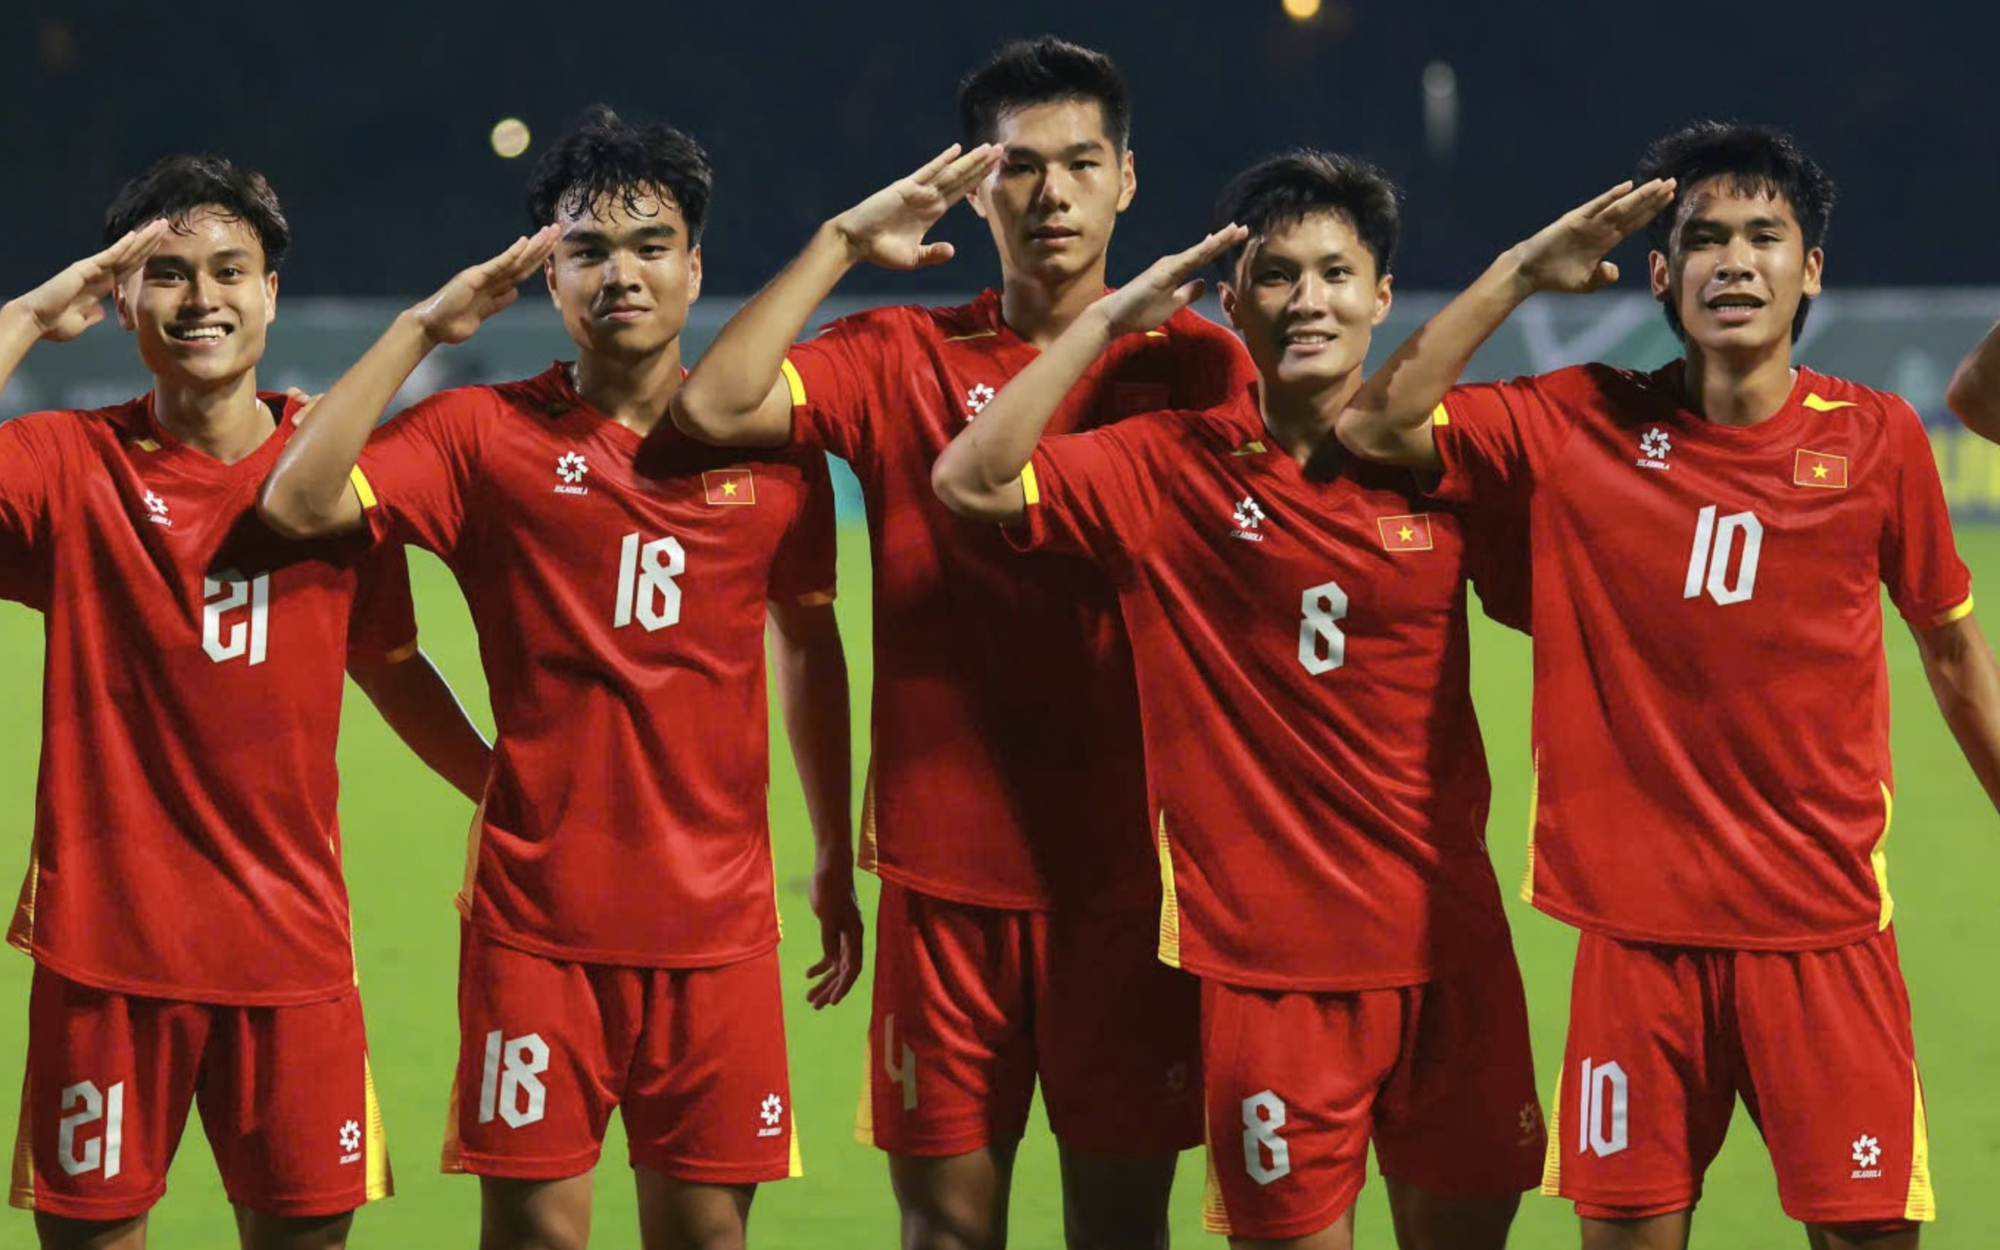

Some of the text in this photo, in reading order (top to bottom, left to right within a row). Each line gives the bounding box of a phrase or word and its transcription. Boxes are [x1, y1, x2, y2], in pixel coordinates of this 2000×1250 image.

[614, 531, 685, 632] 18
[1684, 505, 1763, 605] 10
[202, 570, 269, 667] 21
[1298, 582, 1348, 675] 8
[479, 1030, 550, 1128] 18
[884, 1012, 918, 1110] 4
[1579, 1056, 1628, 1158] 10
[60, 1081, 123, 1179] 21
[1243, 1090, 1291, 1185] 8
